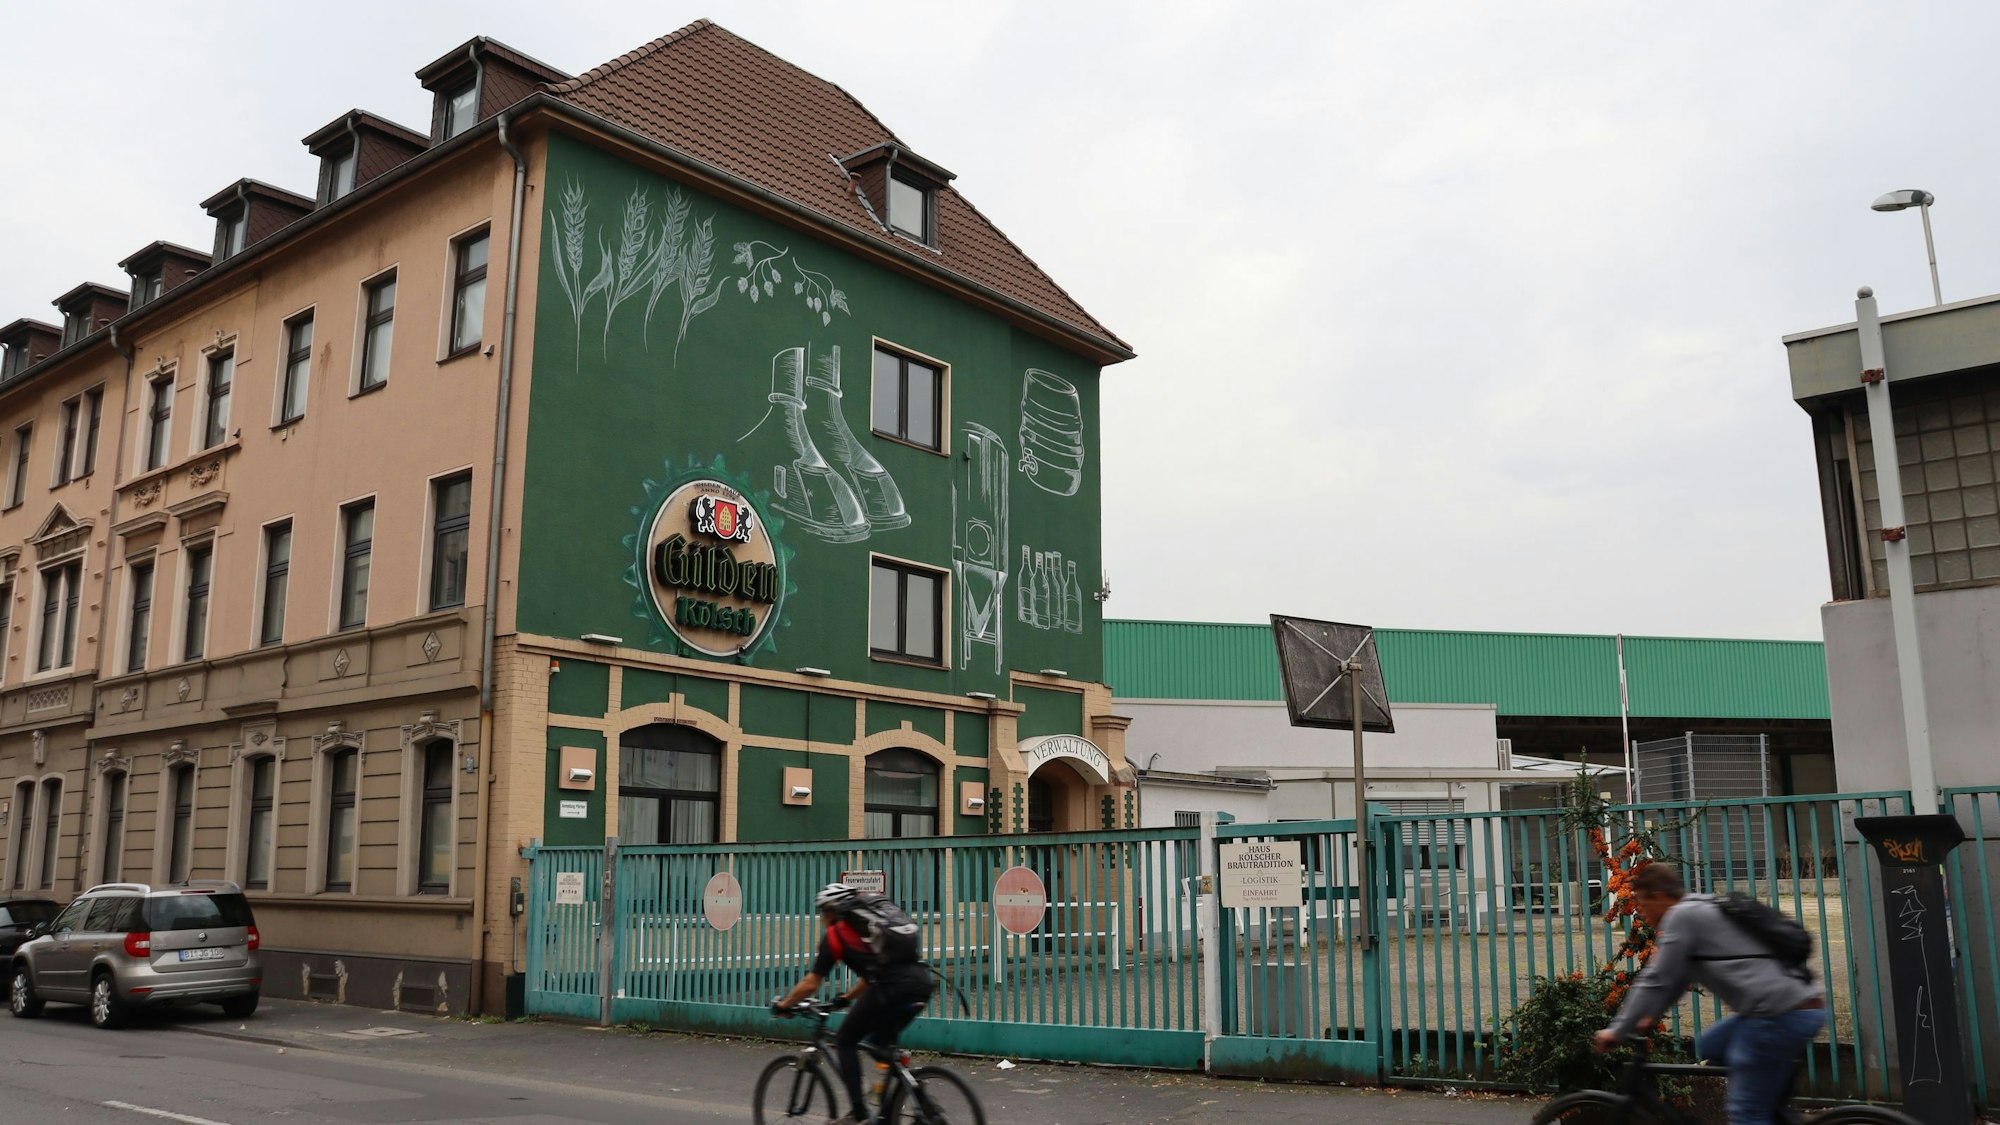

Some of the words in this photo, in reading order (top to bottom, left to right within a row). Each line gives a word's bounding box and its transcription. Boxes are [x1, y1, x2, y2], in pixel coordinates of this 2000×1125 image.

[656, 533, 777, 604] Gilden
[676, 596, 756, 636] Kölsch
[1033, 738, 1102, 767] VERWALTUNG
[1238, 852, 1281, 861] KÖLSCHER
[1227, 860, 1293, 869] BRAUTRADITION
[845, 876, 881, 884] Feuerwehrzufahrt
[1242, 889, 1278, 897] EINFAHRT
